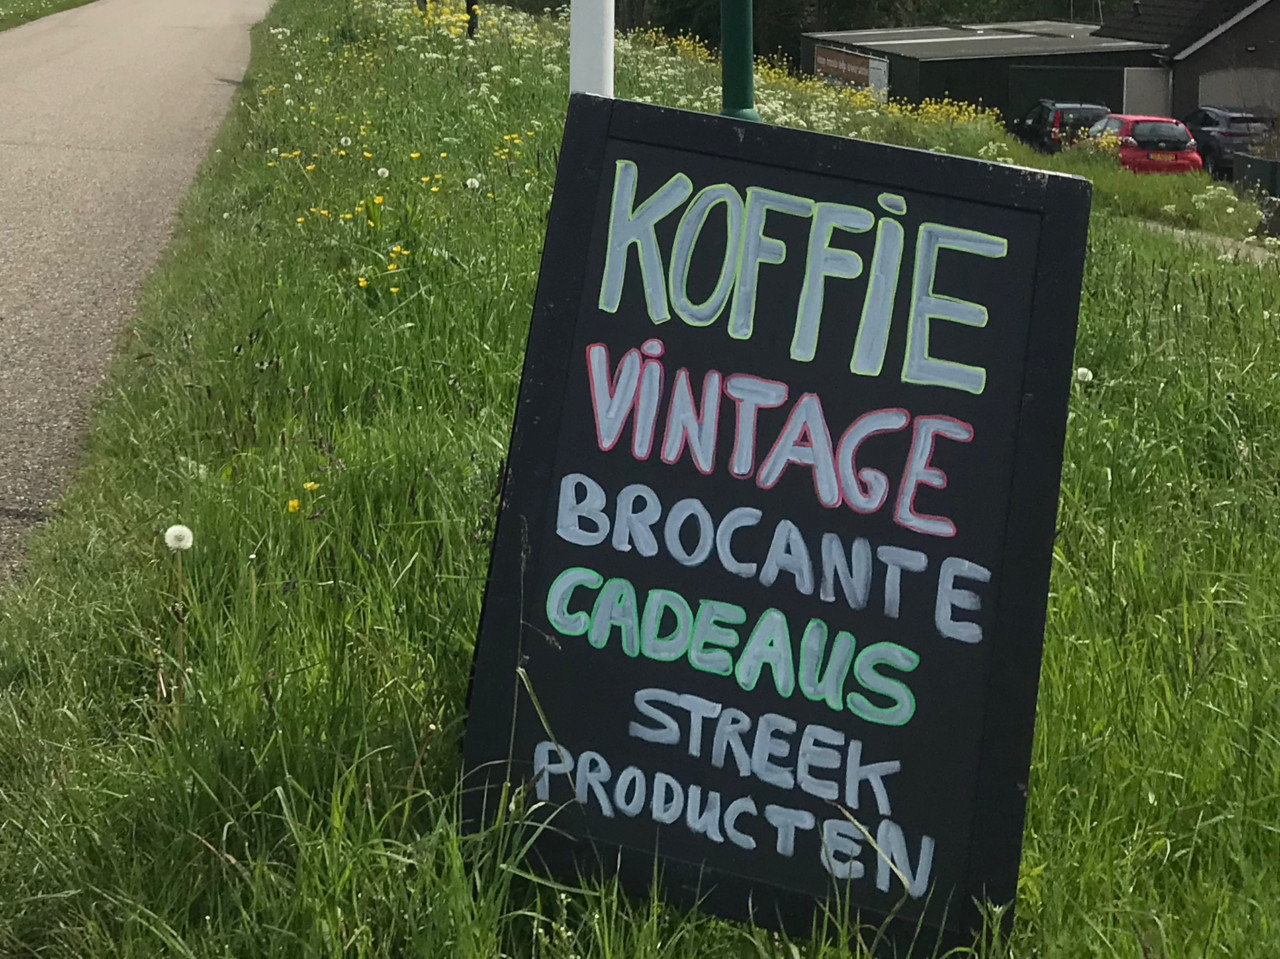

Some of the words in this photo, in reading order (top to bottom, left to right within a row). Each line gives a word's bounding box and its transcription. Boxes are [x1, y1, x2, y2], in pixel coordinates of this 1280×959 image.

[556, 473, 991, 643] BROCANTE
[546, 567, 920, 726] CADEAUS
[533, 741, 935, 898] PRODUCTEN
[629, 688, 901, 816] STREEK
